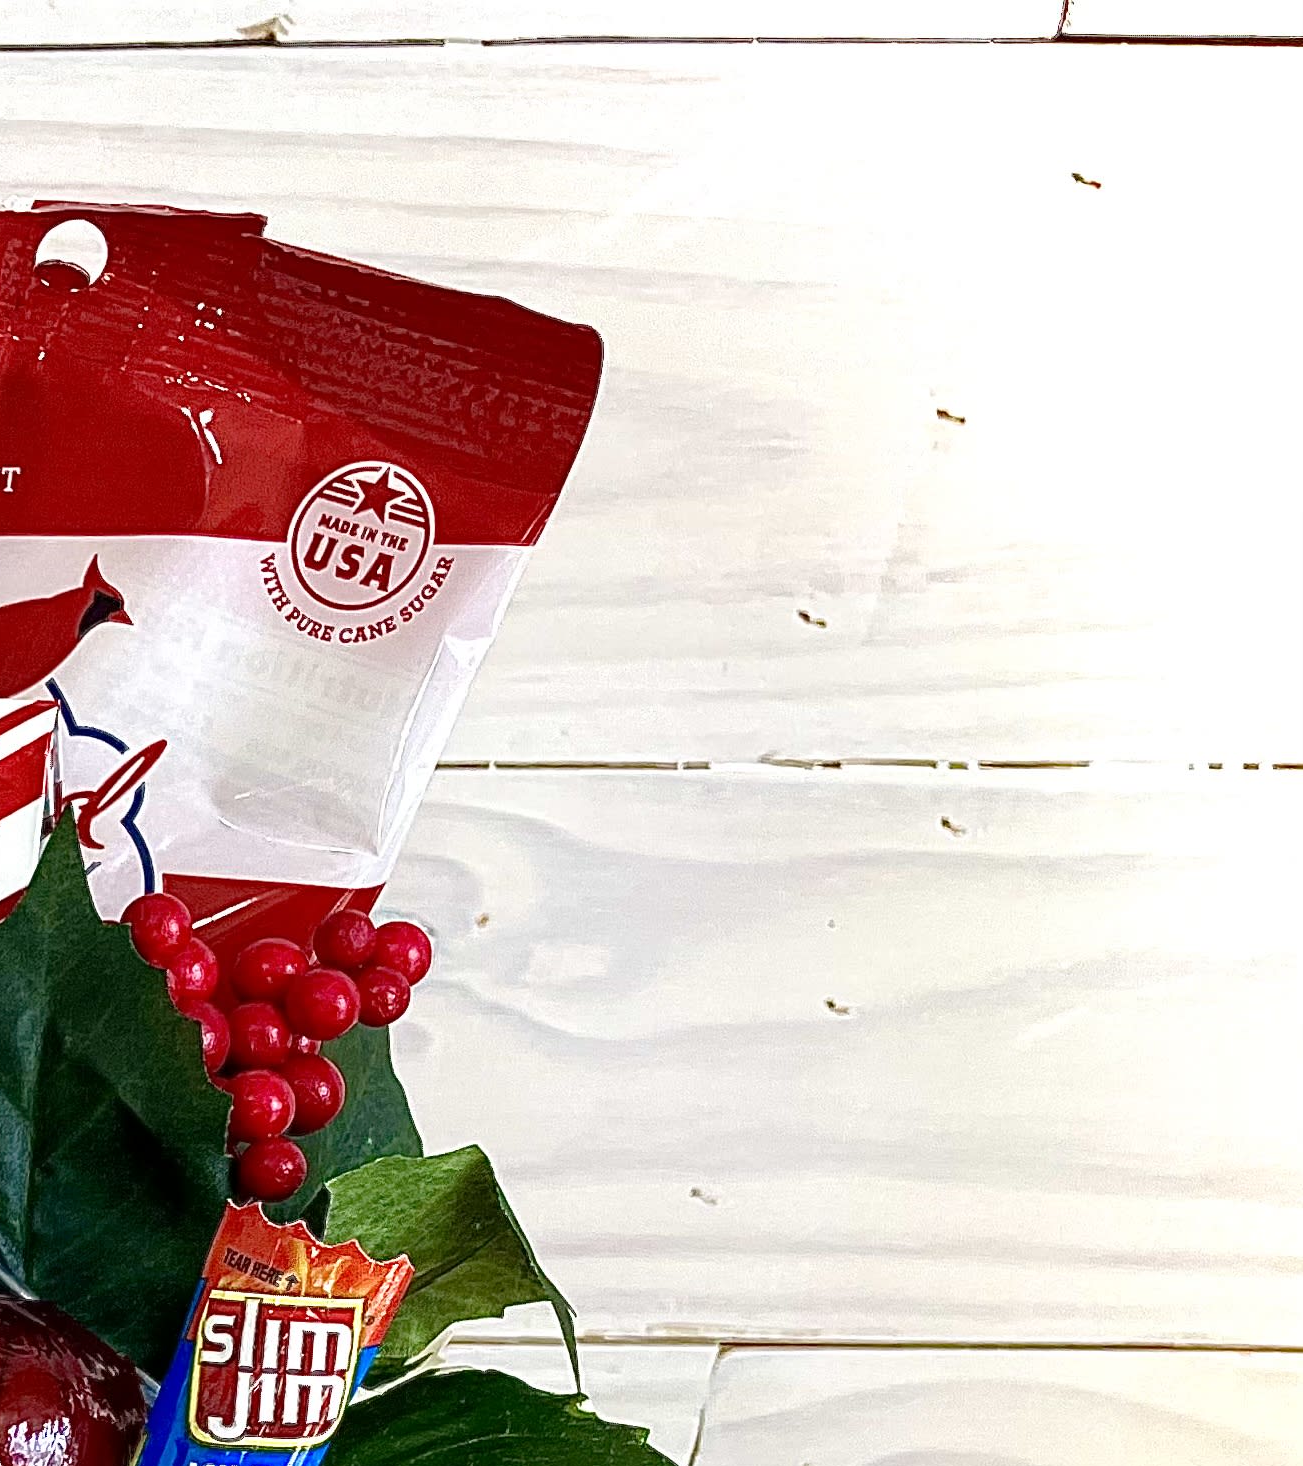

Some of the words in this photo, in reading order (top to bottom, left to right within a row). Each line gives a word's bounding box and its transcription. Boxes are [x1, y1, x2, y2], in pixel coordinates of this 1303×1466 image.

[318, 513, 357, 537] MADE
[361, 526, 378, 543] IN
[381, 532, 409, 552] THE
[304, 532, 394, 593] USA
[260, 552, 291, 612] WITH
[284, 606, 335, 643] PURE
[338, 615, 397, 644] CANE
[399, 556, 455, 623] SUGAR
[222, 1248, 252, 1274] TEAR
[250, 1261, 285, 1288] HERE
